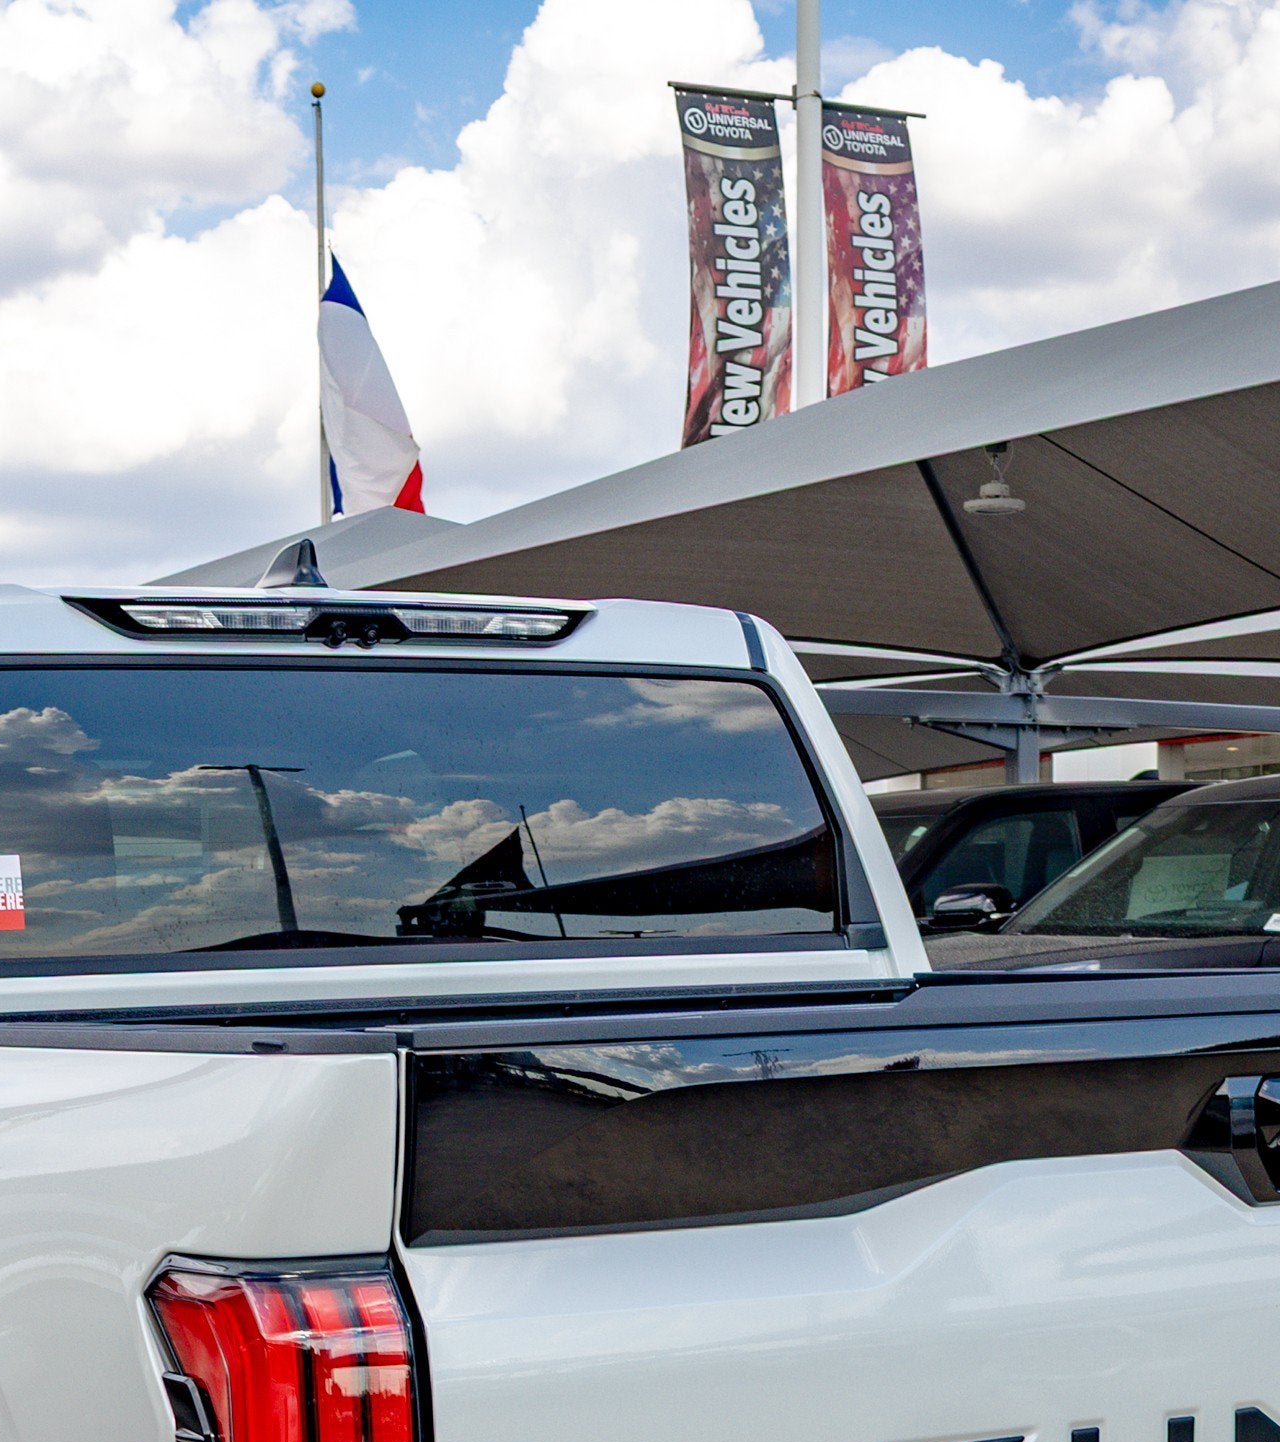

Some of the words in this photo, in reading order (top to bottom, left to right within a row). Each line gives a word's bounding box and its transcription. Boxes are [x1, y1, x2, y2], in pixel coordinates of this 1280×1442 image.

[707, 112, 772, 130] UNIVERSAL
[708, 124, 753, 140] TOYOTA
[843, 129, 905, 147] UNIVERSAL
[844, 140, 887, 156] TOYOTA
[714, 177, 763, 352] Vehicles
[852, 191, 898, 361] Vehicles
